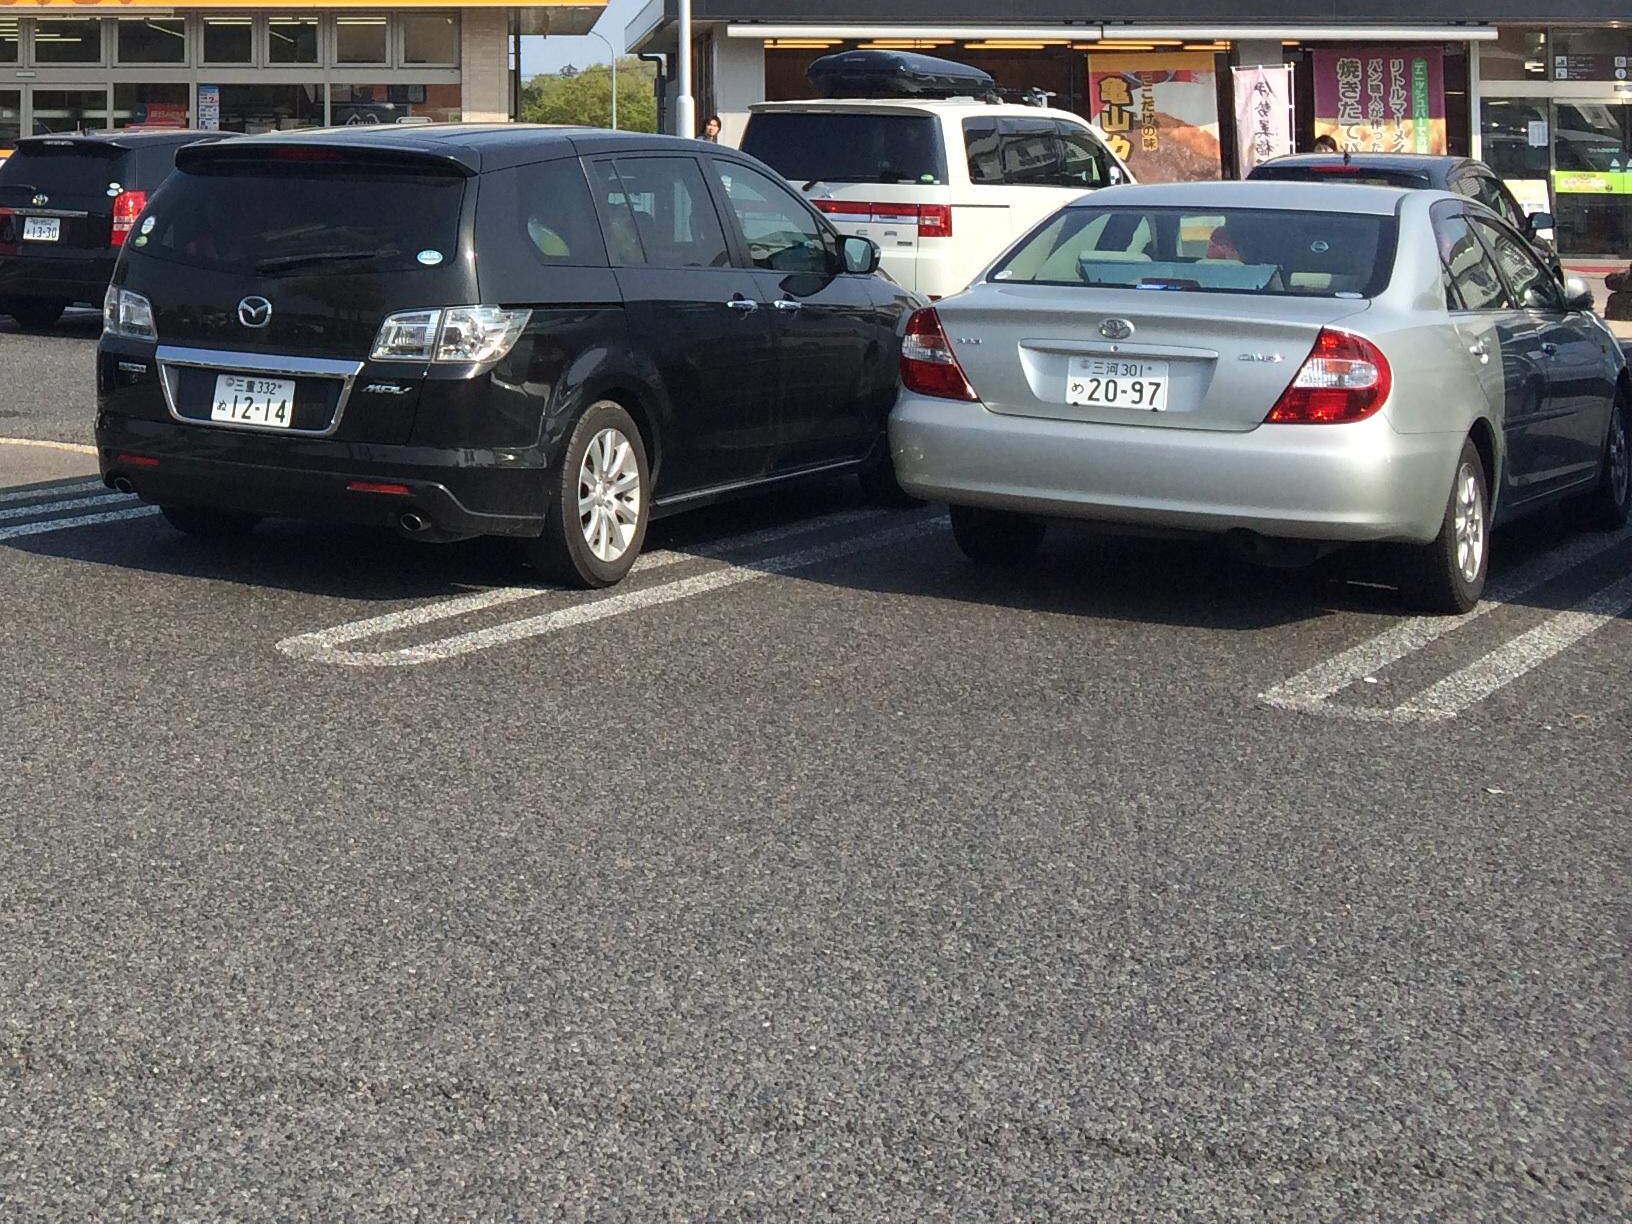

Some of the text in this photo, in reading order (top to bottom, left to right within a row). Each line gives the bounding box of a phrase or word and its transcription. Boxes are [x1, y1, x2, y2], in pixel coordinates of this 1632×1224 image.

[1071, 378, 1161, 406] め 20-97
[231, 394, 287, 423] 12-14
